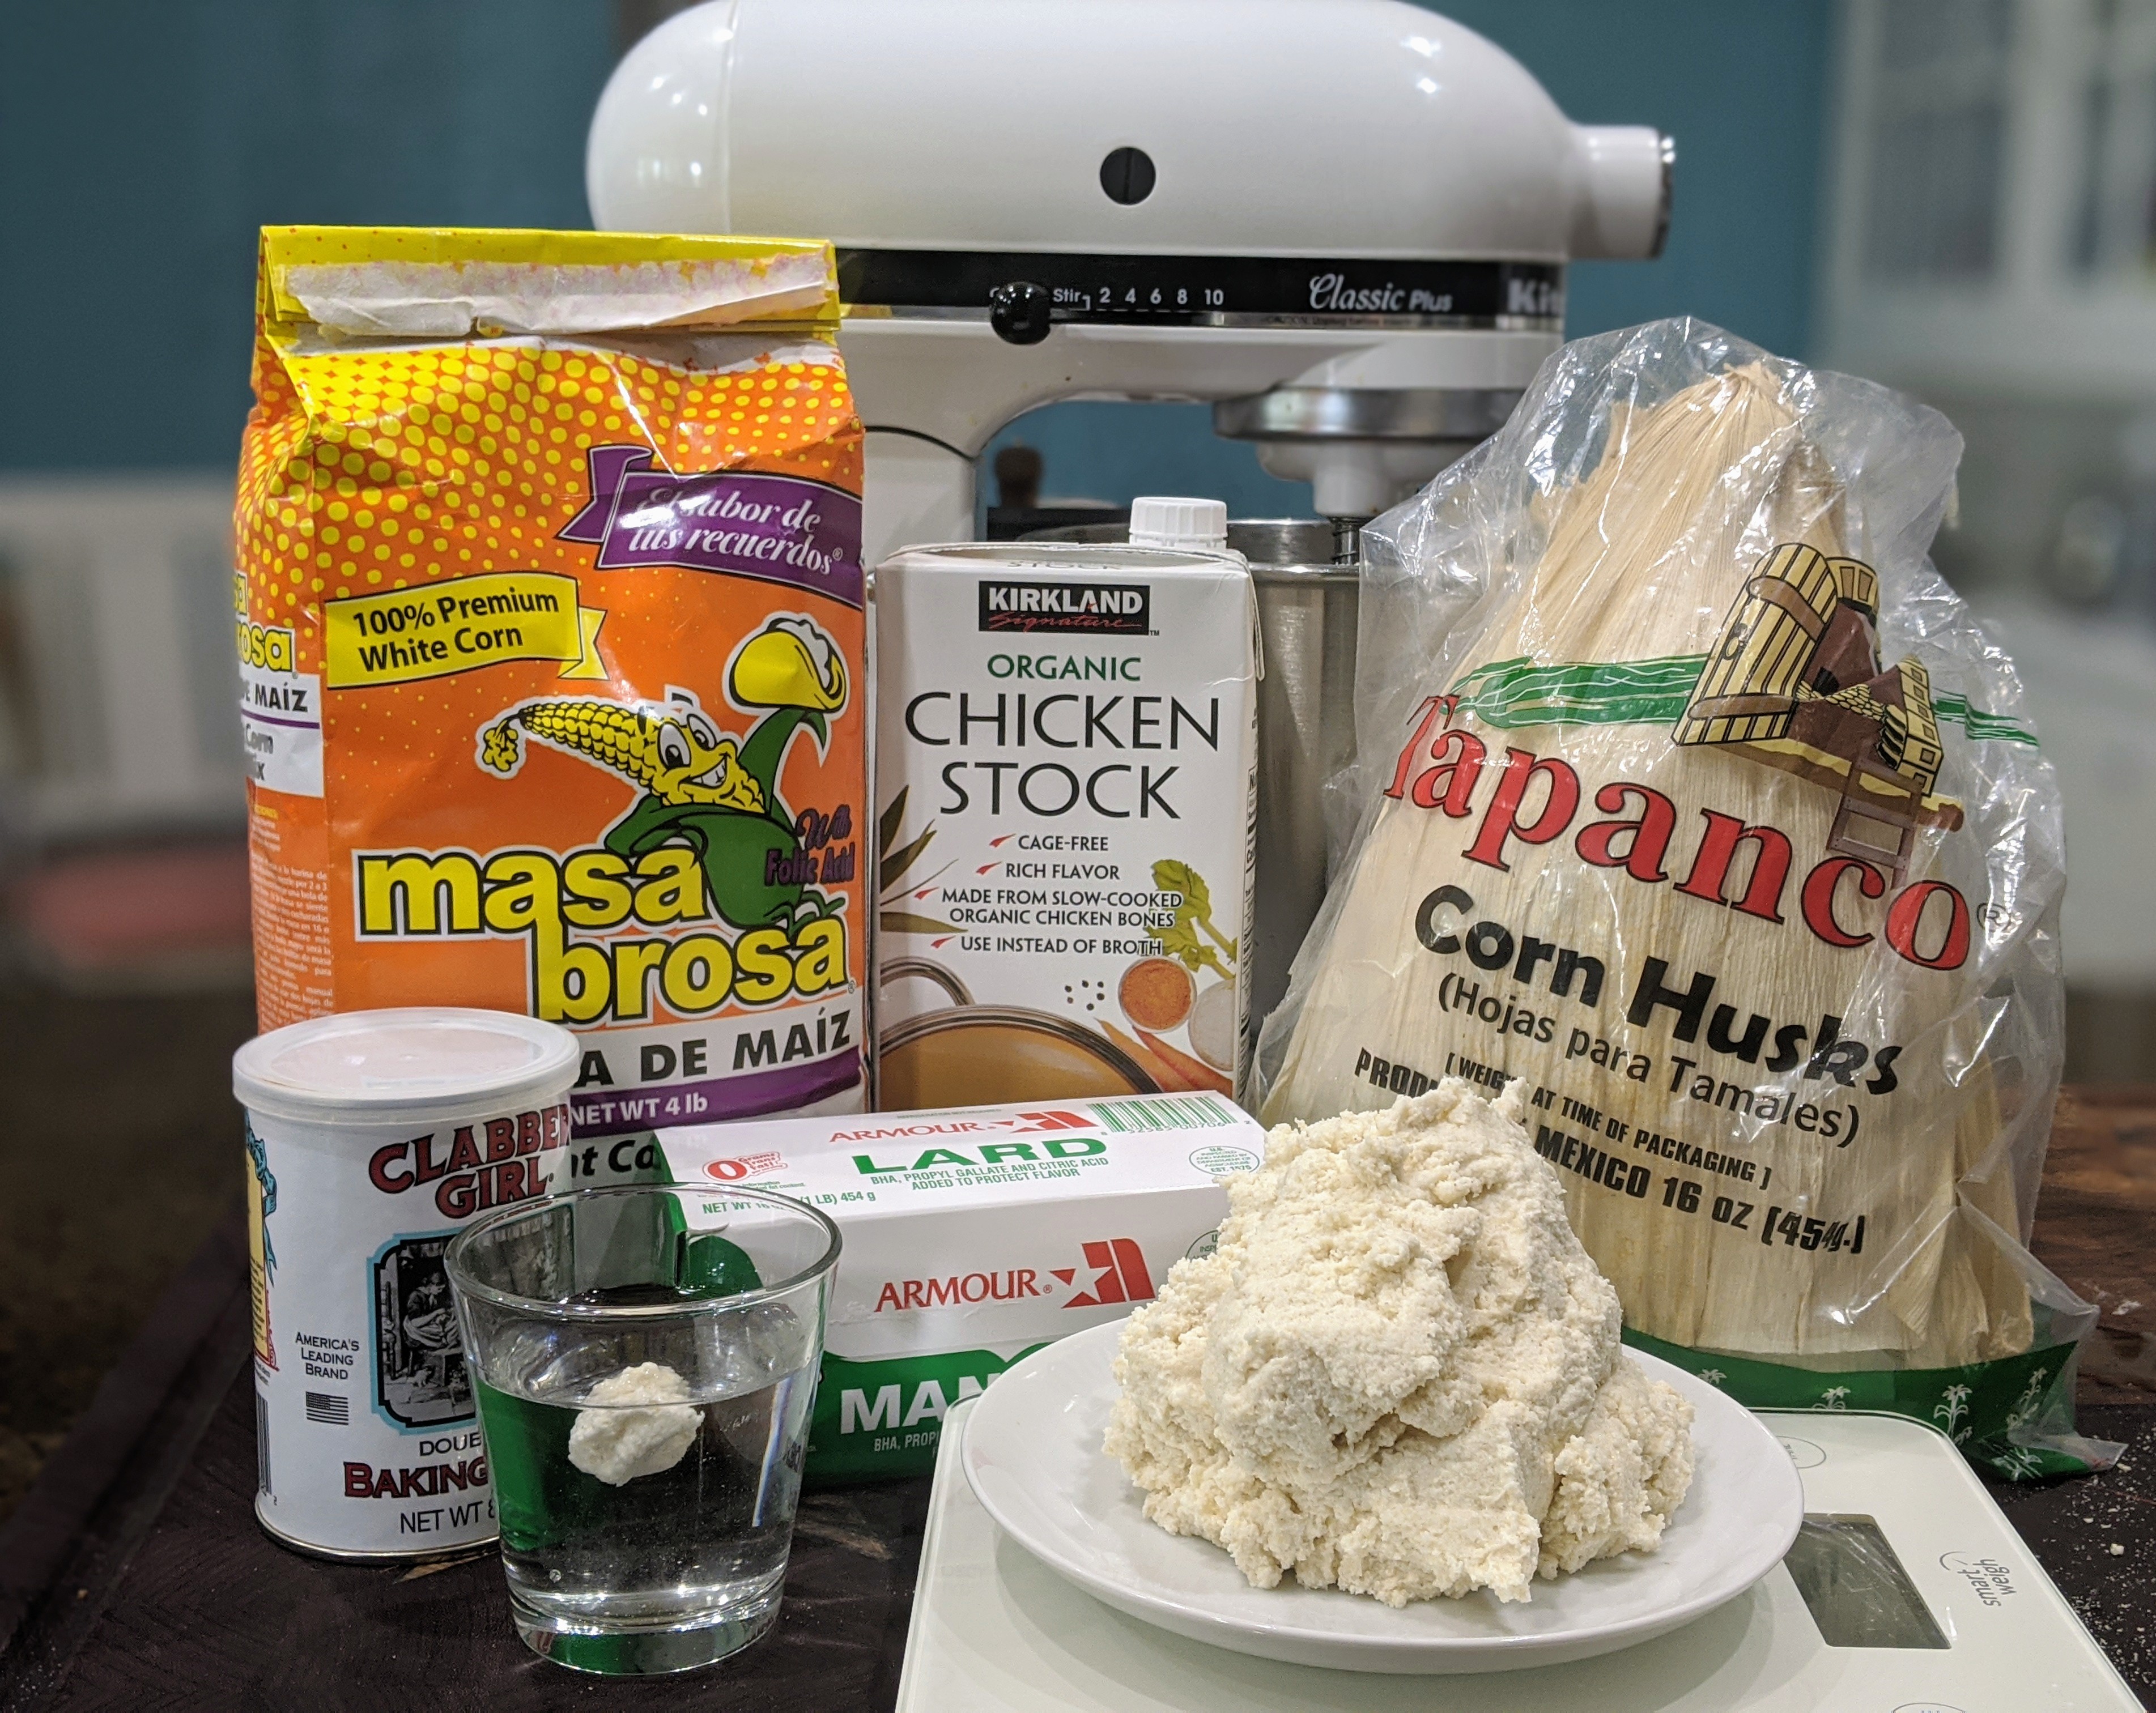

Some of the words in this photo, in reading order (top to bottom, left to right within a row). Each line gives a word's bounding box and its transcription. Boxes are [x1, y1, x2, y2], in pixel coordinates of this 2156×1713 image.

[1053, 288, 1081, 302] Stir
[1100, 287, 1111, 303] 2
[1125, 288, 1136, 303] 4
[1150, 288, 1162, 304] 6
[1177, 289, 1188, 304] 8
[1205, 290, 1224, 305] 10
[1309, 273, 1405, 311] Classic
[1408, 289, 1453, 312] Plus
[782, 499, 821, 532] de
[684, 529, 832, 575] recuerdos
[354, 603, 435, 637] 100%
[437, 587, 559, 619] Premium
[989, 587, 1143, 614] KIRKLAND
[989, 611, 1142, 632] Signature
[359, 640, 448, 671] White
[456, 625, 522, 653] Corn
[987, 654, 1141, 681] ORGANIC
[256, 683, 308, 712] MAÍZ
[905, 692, 1219, 752] CHICKEN
[940, 761, 1180, 819] STOCK
[1018, 836, 1108, 851] CAGE-FREE
[1383, 694, 1970, 971] Tapanco
[764, 848, 818, 886] Folic
[1006, 863, 1046, 879] RICH
[1052, 864, 1119, 880] FLAVOR
[357, 847, 712, 936] masa
[942, 889, 991, 904] MADE
[997, 890, 1047, 905] FROM
[1052, 892, 1182, 907] SLOW-COOKED
[950, 908, 1031, 925] ORGANIC
[1036, 910, 1112, 927] CHICKEN
[1118, 911, 1174, 928] BONES
[961, 936, 991, 952] USE
[997, 938, 1068, 954] INSTEAD
[1073, 939, 1097, 954] OF
[1103, 940, 1162, 956] BROTH
[533, 916, 850, 1025] brosa
[1414, 884, 1604, 1008] Corn
[1626, 956, 1902, 1096] Husks
[641, 1039, 707, 1081] DE
[733, 1007, 850, 1069] MAÍZ
[1438, 972, 1557, 1042] (Hojas
[1565, 1029, 1651, 1083] para
[1666, 1055, 1860, 1148] Tamales)
[571, 1102, 616, 1126] NET
[620, 1098, 661, 1121] WT
[665, 1097, 680, 1115] 4
[685, 1092, 708, 1114] lb
[368, 1103, 569, 1194] CLABBER
[830, 1122, 985, 1144] ARMOUR
[1531, 1087, 1557, 1110] AT
[1560, 1095, 1602, 1131] TIME
[1605, 1117, 1629, 1143] OF
[1634, 1129, 1757, 1182] PACKAGING
[851, 1138, 1106, 1174] LARD
[870, 1174, 901, 1184] BHA,
[904, 1170, 954, 1183] PROPYL
[956, 1165, 1009, 1178] GALLATE
[1012, 1162, 1037, 1174] AND
[1039, 1160, 1079, 1170] CITRIC
[1081, 1157, 1109, 1167] ACID
[435, 1156, 548, 1220] GIRL
[912, 1178, 952, 1190] ADDED
[955, 1178, 973, 1187] TO
[976, 1173, 1031, 1186] PROTECT
[1034, 1168, 1080, 1179] FLAVOR
[1534, 1125, 1650, 1198] MEXICO
[1662, 1176, 1703, 1213] 16
[1711, 1198, 1754, 1231] OZ
[703, 1202, 728, 1214] NET
[815, 1193, 837, 1206] LB)
[841, 1191, 864, 1202] 454
[867, 1192, 875, 1203] g
[874, 1268, 1041, 1313] ARMOUR
[295, 1332, 359, 1352] AMERICA'S
[301, 1346, 354, 1366] LEADING
[305, 1364, 348, 1380] BRAND
[874, 1437, 900, 1452] BHA,
[344, 1456, 488, 1498] BAKING
[401, 1509, 444, 1534] NET
[449, 1501, 483, 1527] WT
[1957, 1569, 2001, 1606] smart
[1972, 1559, 2017, 1595] weigh
